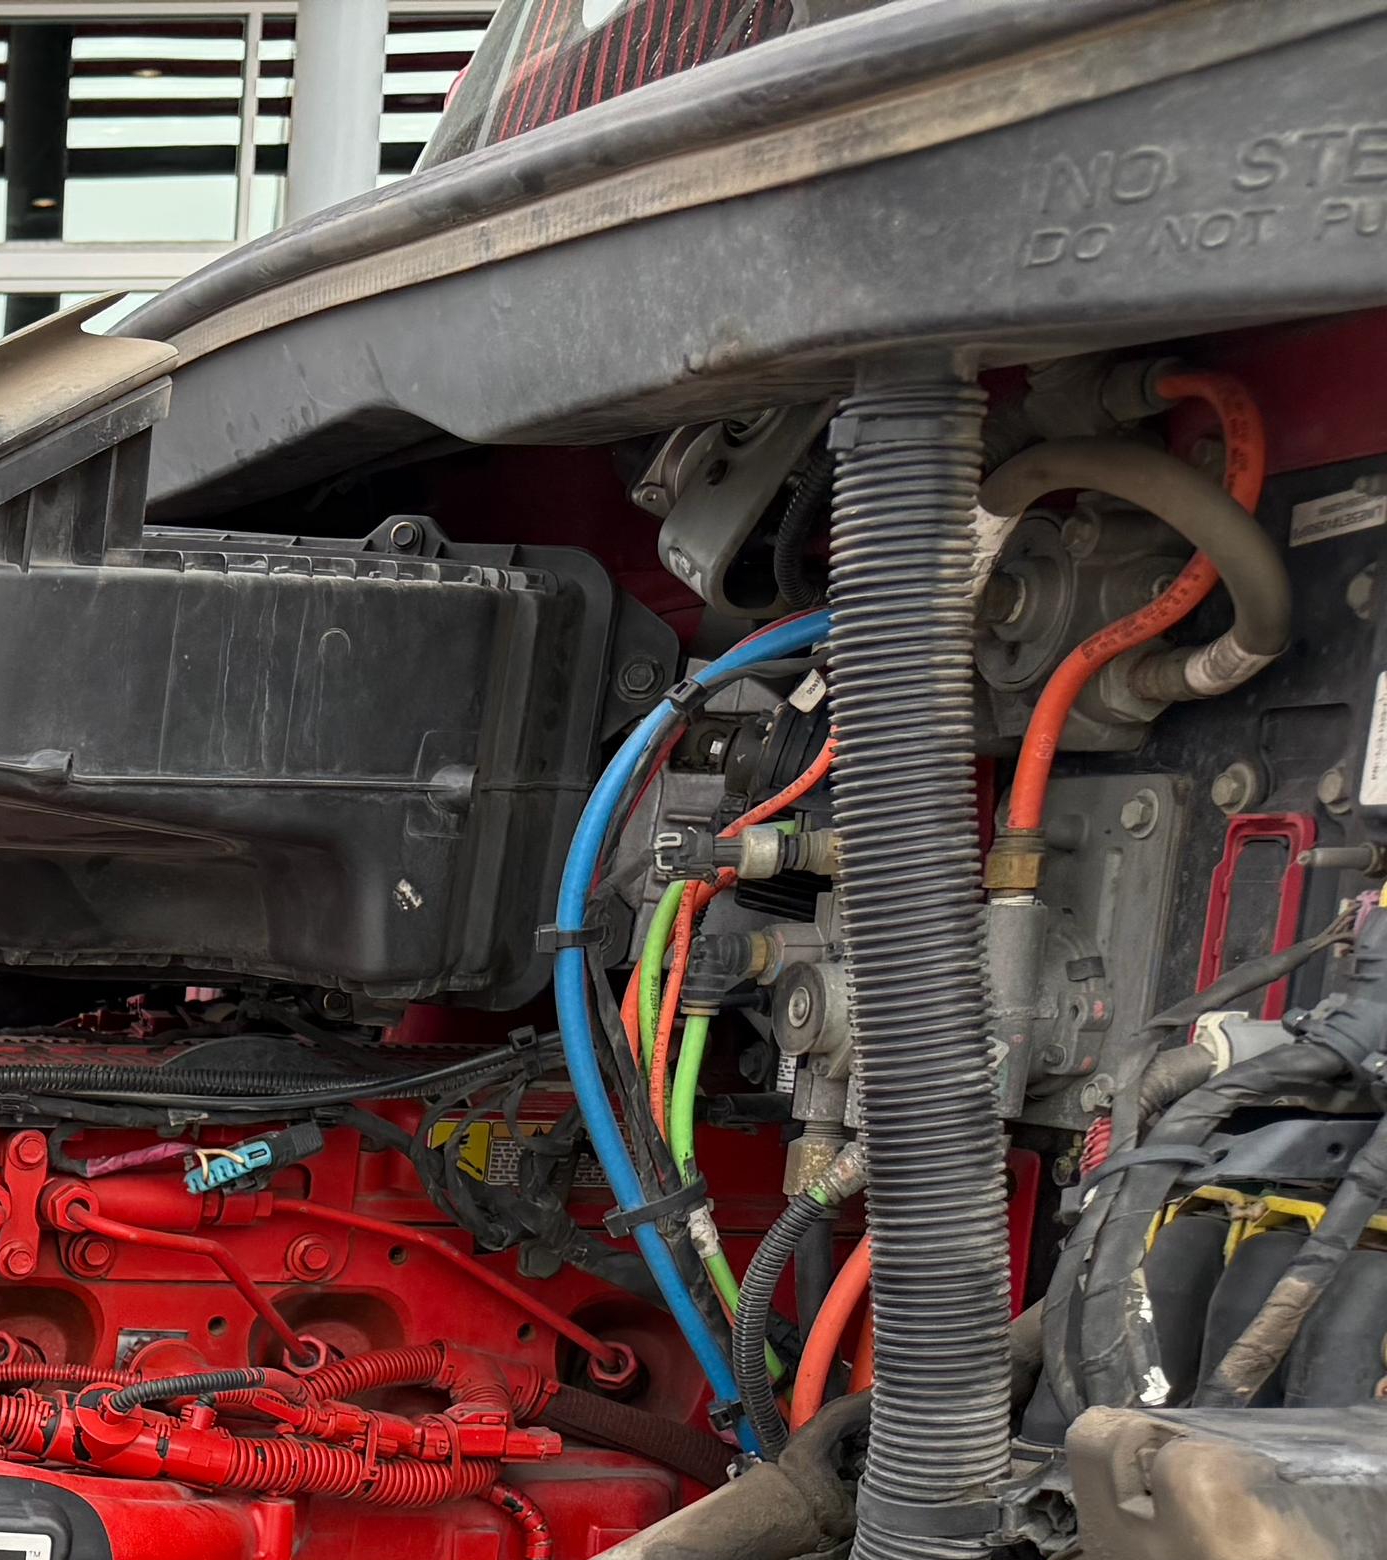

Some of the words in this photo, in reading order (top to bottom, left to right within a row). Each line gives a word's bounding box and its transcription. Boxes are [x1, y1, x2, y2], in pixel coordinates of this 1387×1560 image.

[1038, 145, 1175, 214] NO
[1024, 222, 1115, 268] DO
[1151, 206, 1278, 256] NOT
